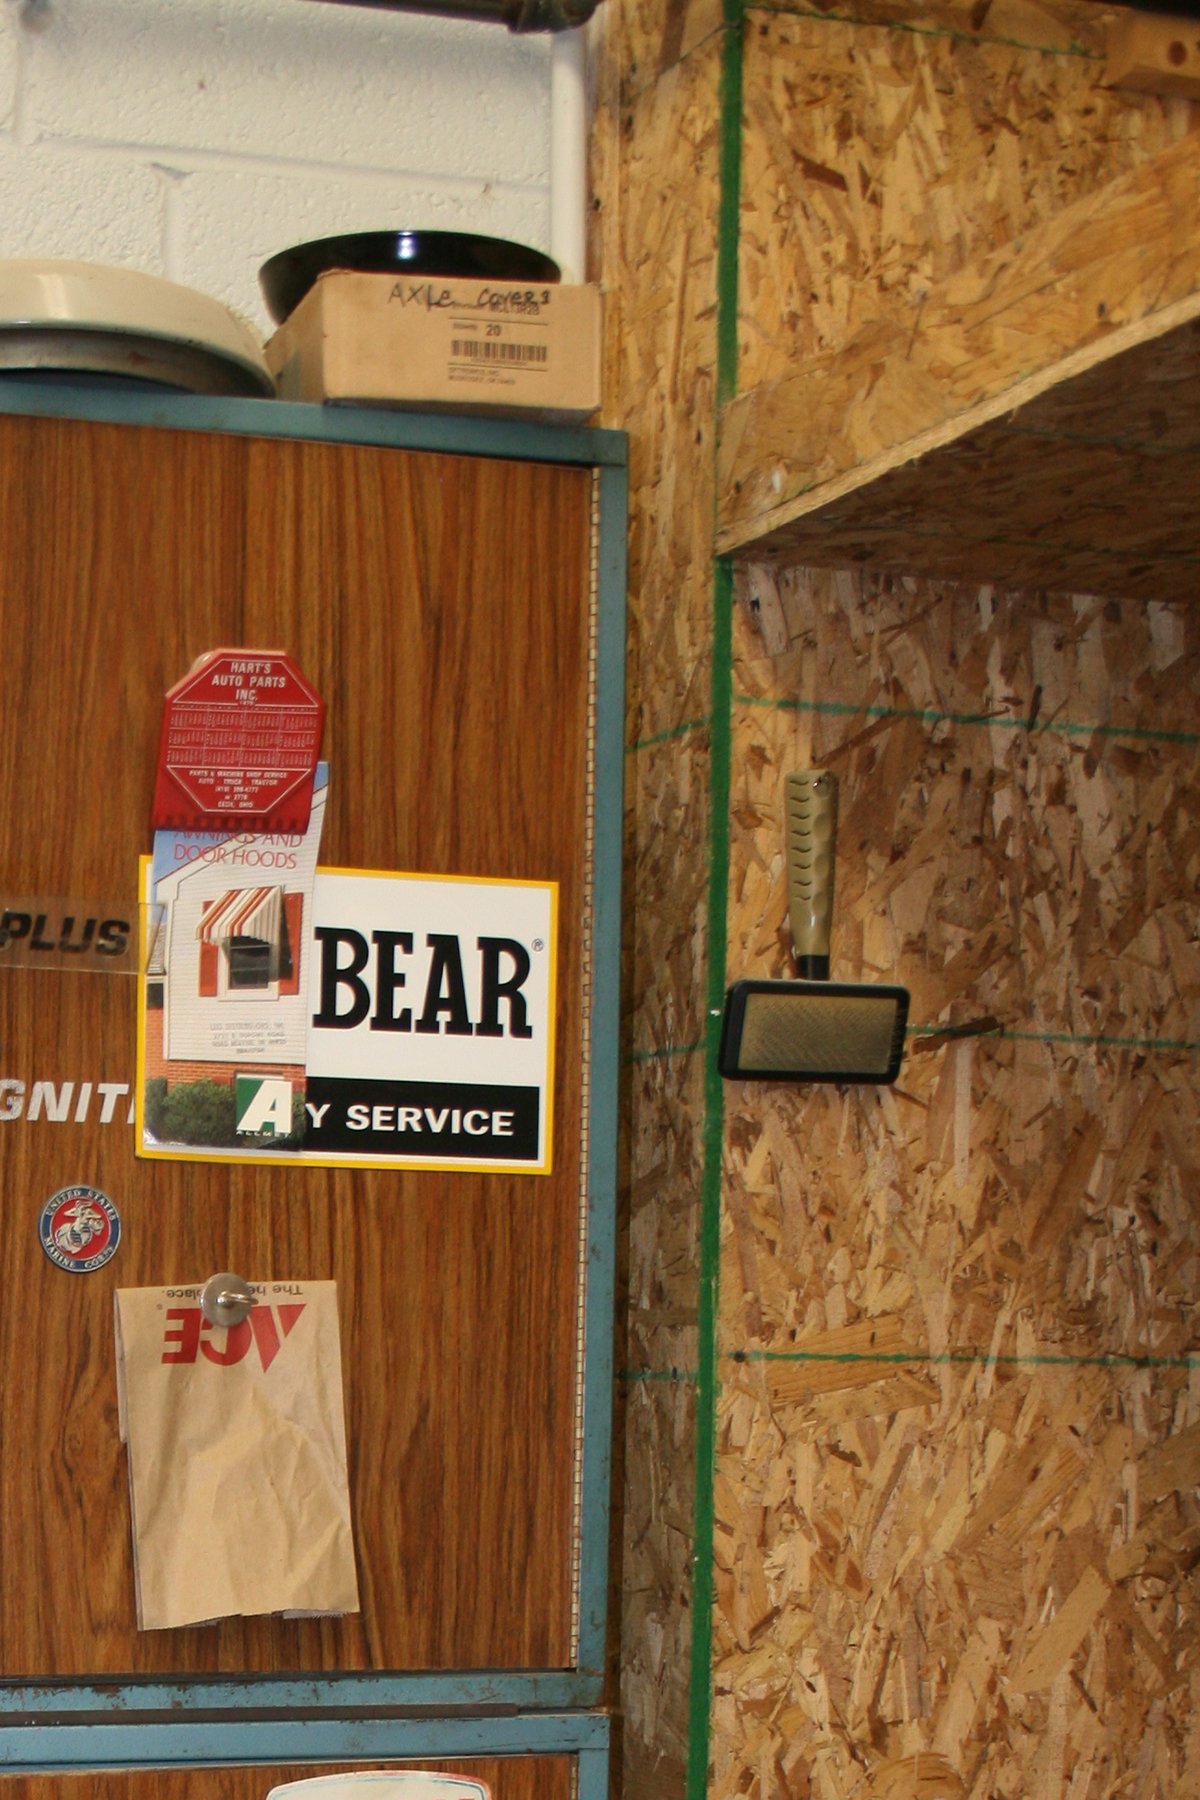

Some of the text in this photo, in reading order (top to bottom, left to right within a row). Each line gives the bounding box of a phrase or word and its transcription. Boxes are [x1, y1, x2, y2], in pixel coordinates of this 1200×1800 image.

[485, 324, 502, 337] 20
[230, 662, 271, 674] HART'S
[211, 675, 286, 688] AUTO PARTS
[261, 833, 303, 848] AND
[173, 843, 297, 869] DOOR HOODS
[312, 926, 533, 1039] BEAR
[345, 1103, 515, 1137] SERVICE
[45, 1189, 116, 1221] UNITED STATES
[44, 1237, 76, 1267] MARINE
[272, 1284, 303, 1295] The
[161, 1303, 306, 1373] ACE
